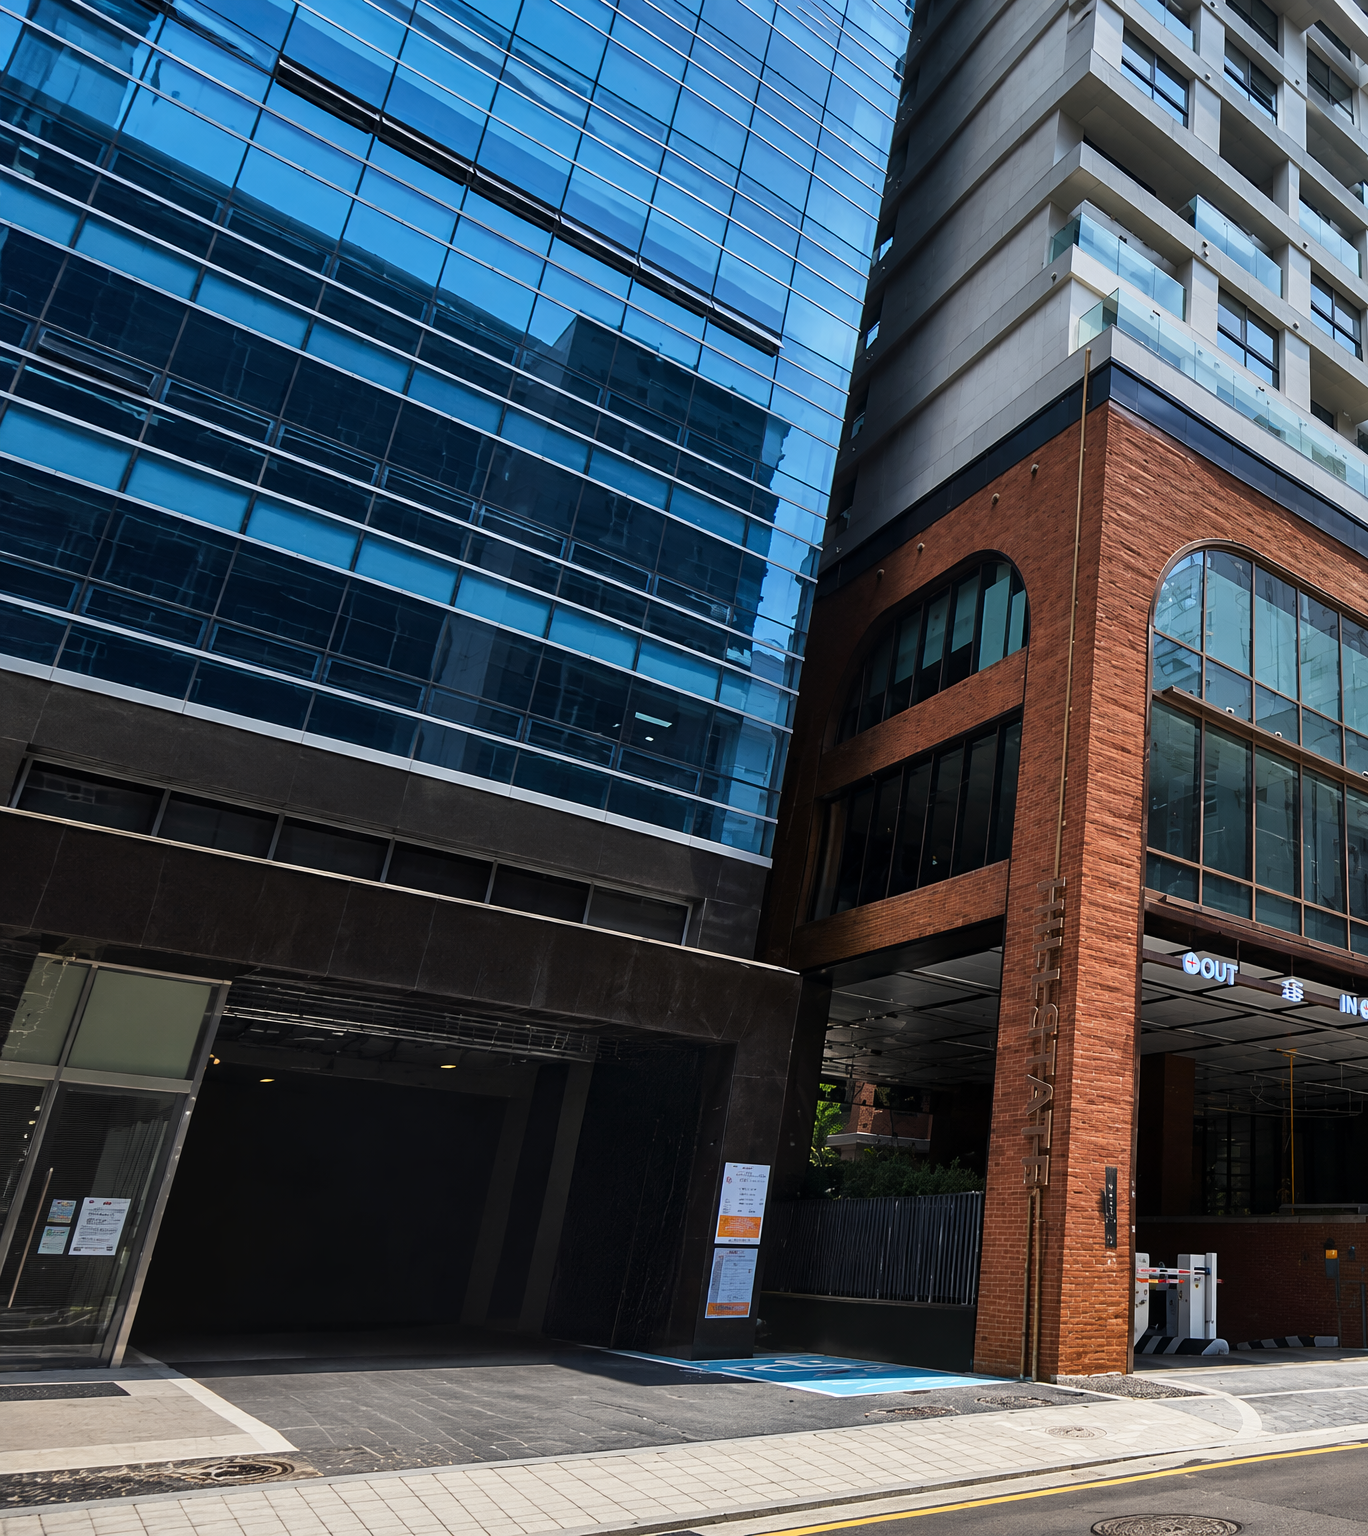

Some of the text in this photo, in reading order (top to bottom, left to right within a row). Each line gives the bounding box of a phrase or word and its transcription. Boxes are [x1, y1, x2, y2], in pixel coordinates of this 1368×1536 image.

[1200, 957, 1238, 986] OUT
[1339, 993, 1358, 1016] IN
[1020, 876, 1066, 1186] HILLSTATE
